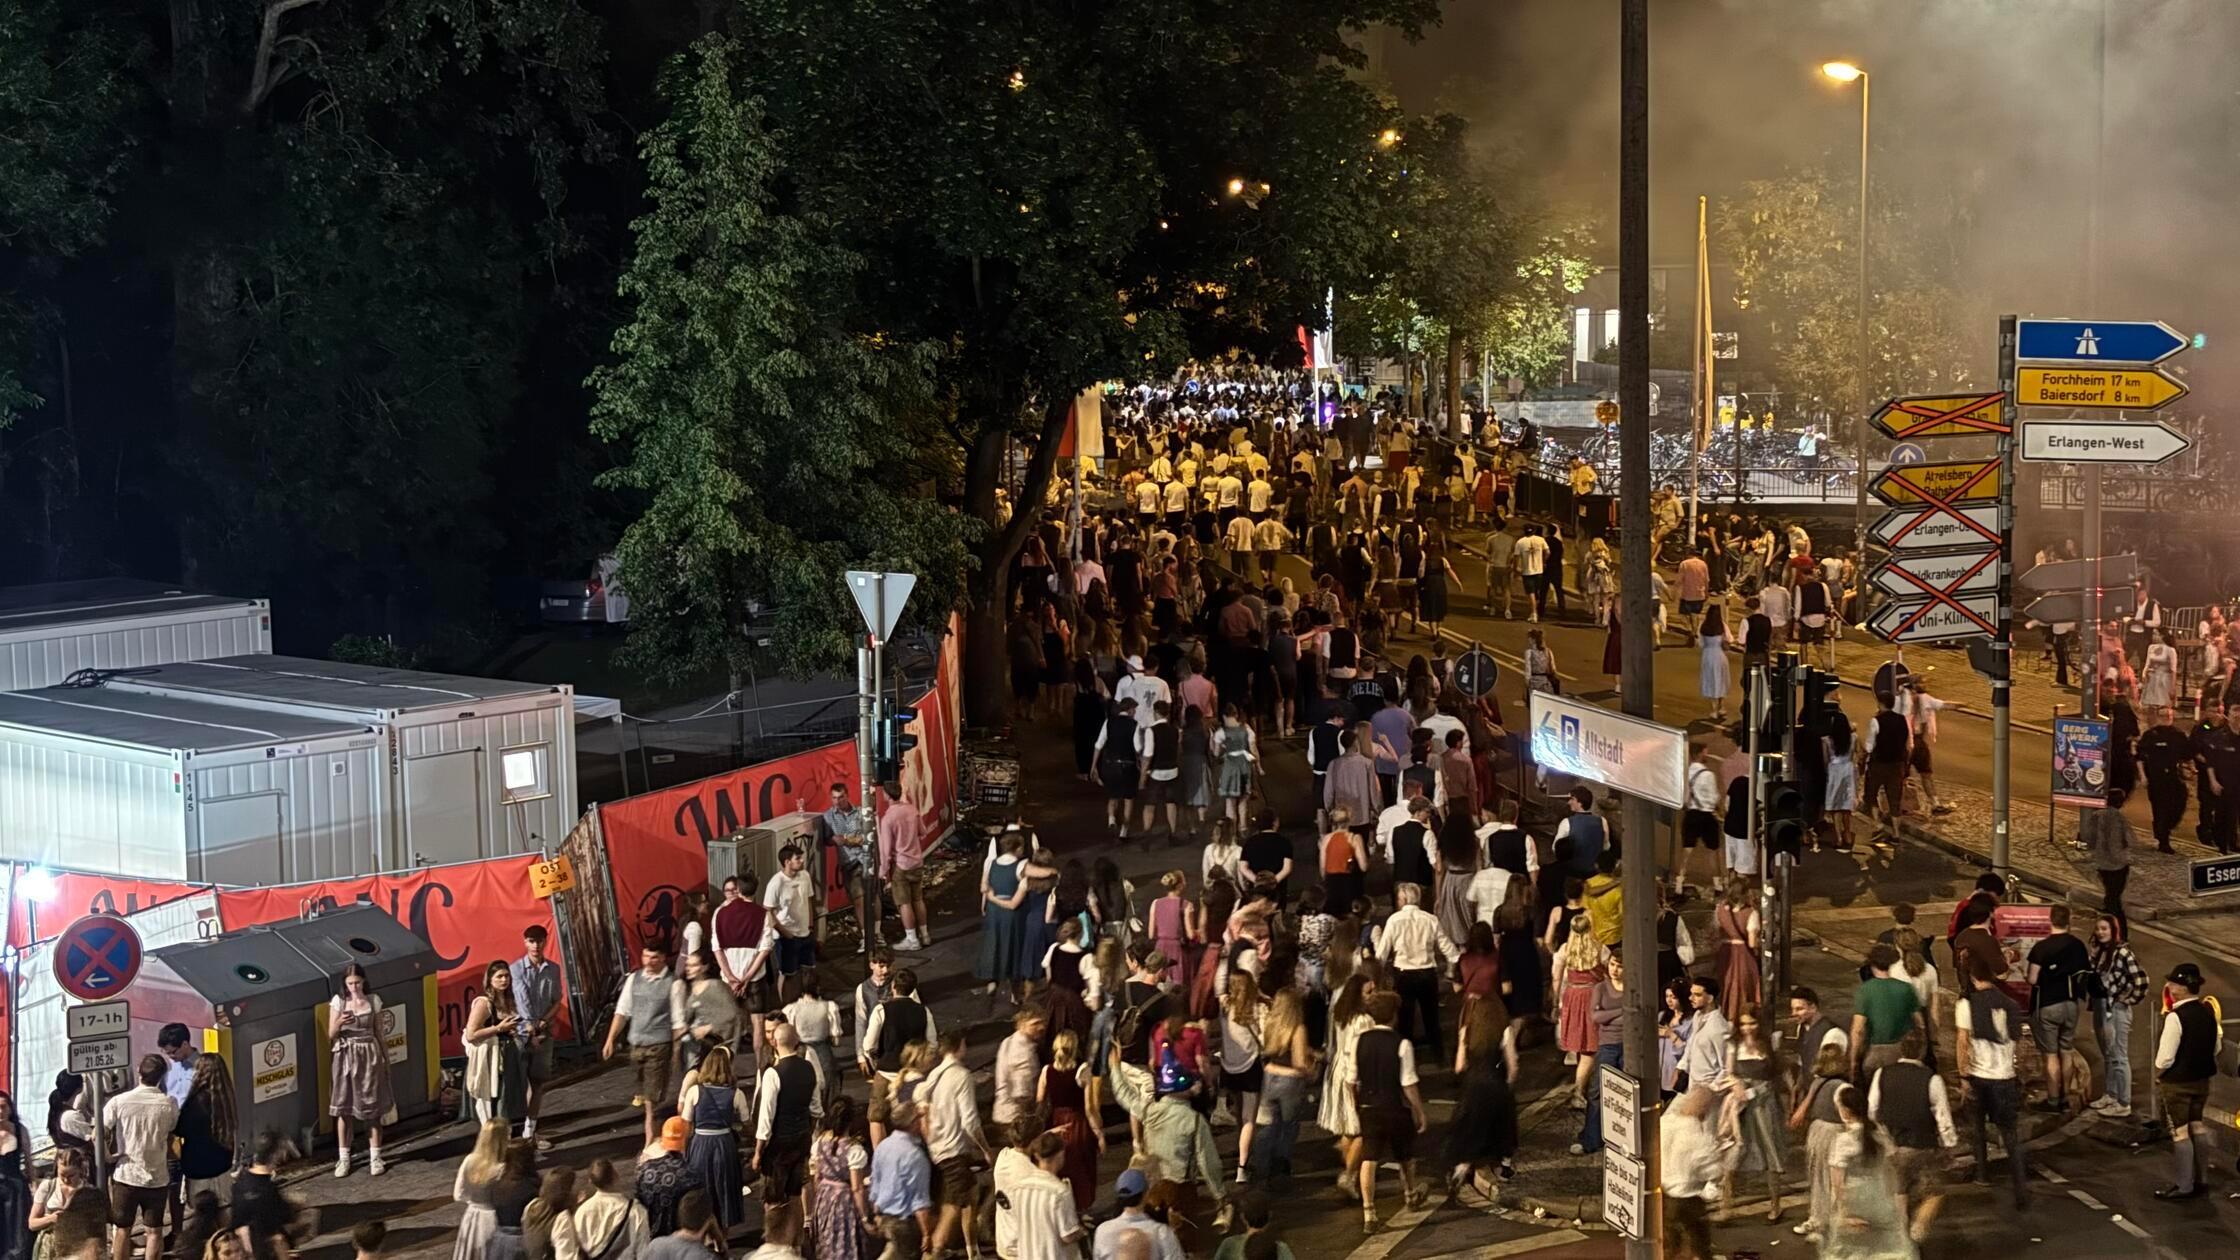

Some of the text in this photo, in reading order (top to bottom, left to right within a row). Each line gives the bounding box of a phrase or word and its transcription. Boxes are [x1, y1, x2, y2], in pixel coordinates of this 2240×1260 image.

[2042, 373, 2141, 387] Forchheim 17 km
[2040, 388, 2141, 403] Baiersdorf 8 km
[2048, 435, 2145, 450] Erlangen-West
[2062, 724, 2089, 734] BERG
[2069, 733, 2099, 743] WERK
[1585, 730, 1624, 766] Altstadt
[540, 861, 561, 875] OST
[73, 1043, 100, 1057] gültig
[85, 1054, 115, 1068] 21.05.26
